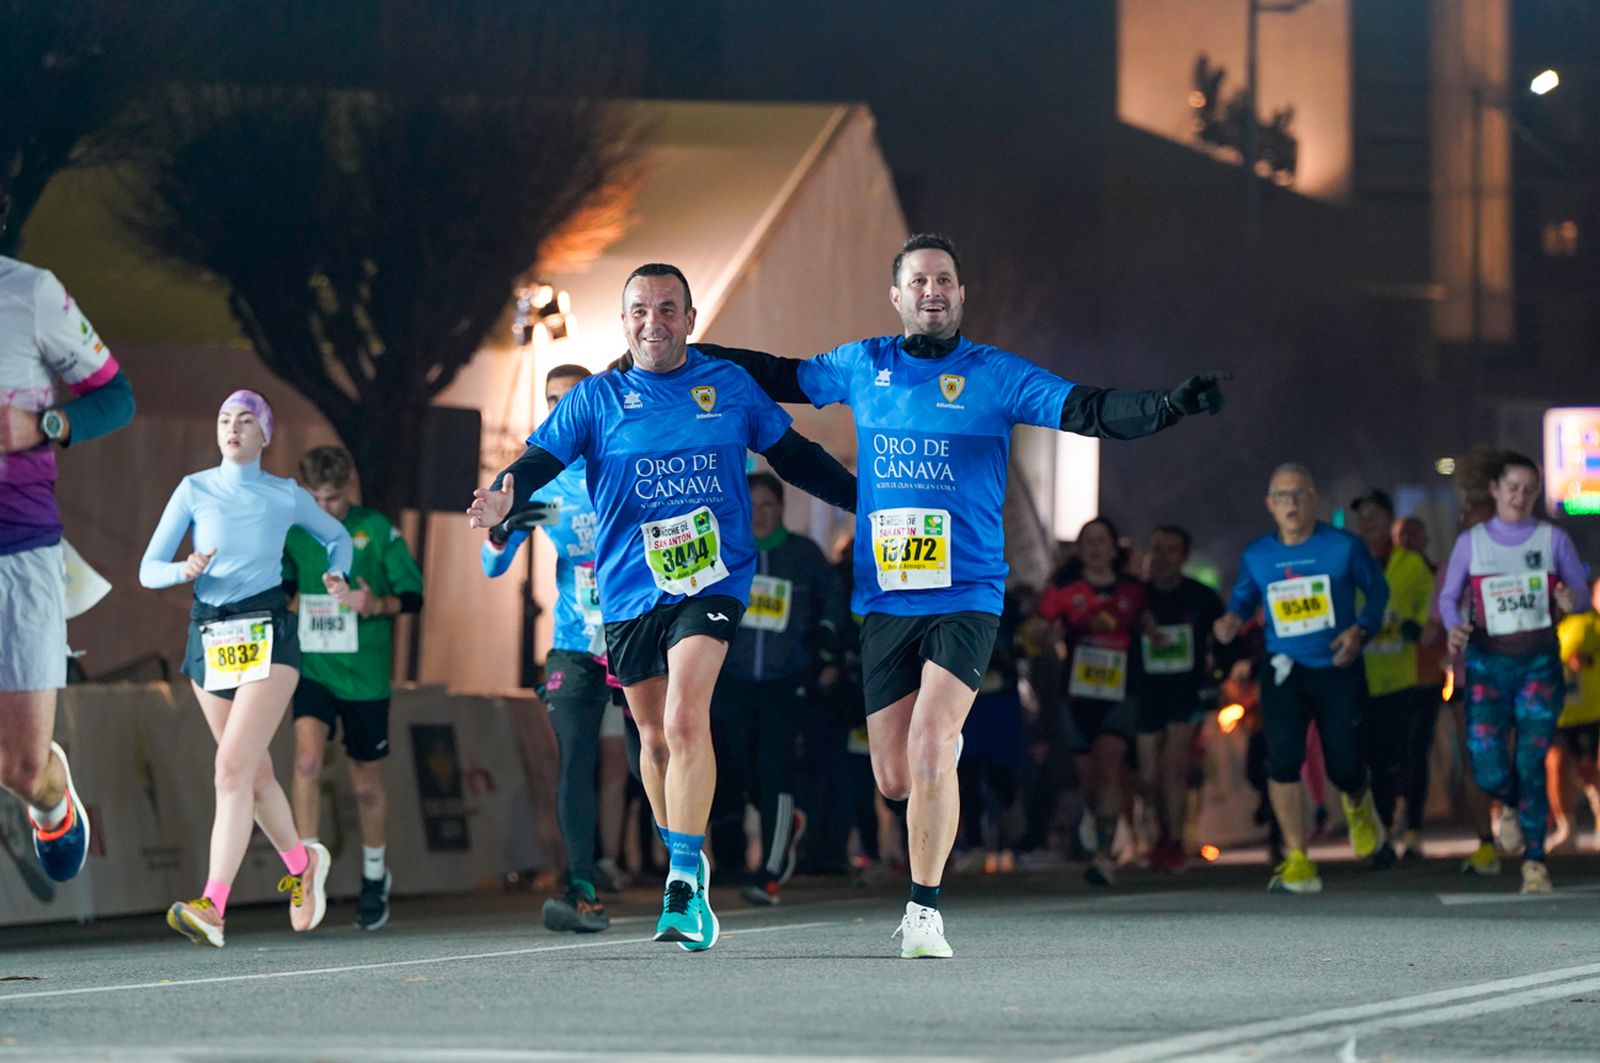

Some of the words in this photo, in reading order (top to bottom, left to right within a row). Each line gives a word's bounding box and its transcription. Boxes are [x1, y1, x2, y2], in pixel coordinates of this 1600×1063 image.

[873, 433, 917, 455] ORO
[923, 439, 950, 458] DE
[635, 457, 685, 477] ORO
[692, 453, 717, 471] DE
[873, 454, 955, 482] CÁNAVA
[635, 476, 722, 500] CÁNAVA
[660, 526, 681, 538] NOCHE
[680, 522, 689, 531] DE
[906, 517, 916, 525] DE
[654, 539, 668, 550] SAN
[662, 536, 709, 573] 3444
[1497, 592, 1536, 613] 3542
[218, 643, 260, 667] 8832
